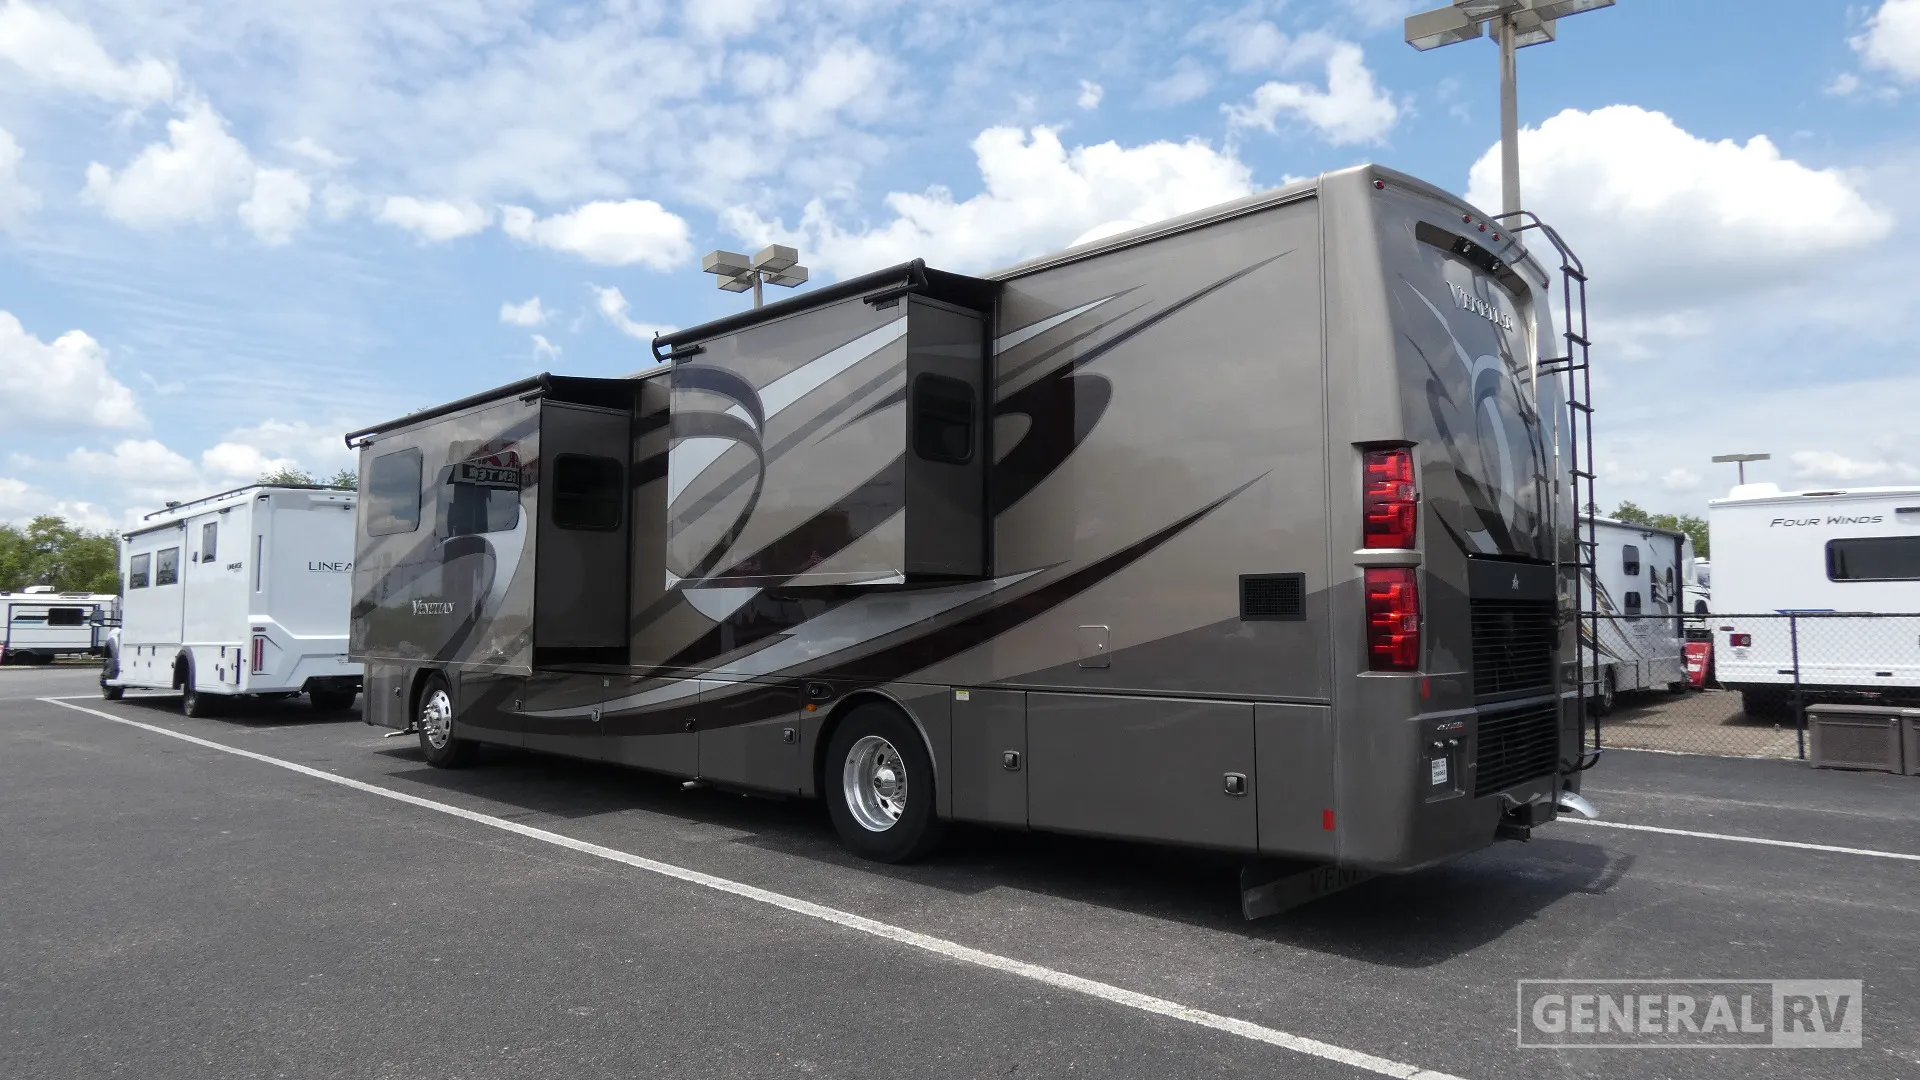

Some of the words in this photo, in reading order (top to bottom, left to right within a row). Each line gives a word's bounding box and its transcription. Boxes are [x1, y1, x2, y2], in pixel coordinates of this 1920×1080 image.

[1446, 281, 1513, 332] VENETIAN
[1770, 518, 1820, 527] FOUR
[1827, 515, 1883, 525] WINDS
[412, 600, 455, 615] VENETIAN
